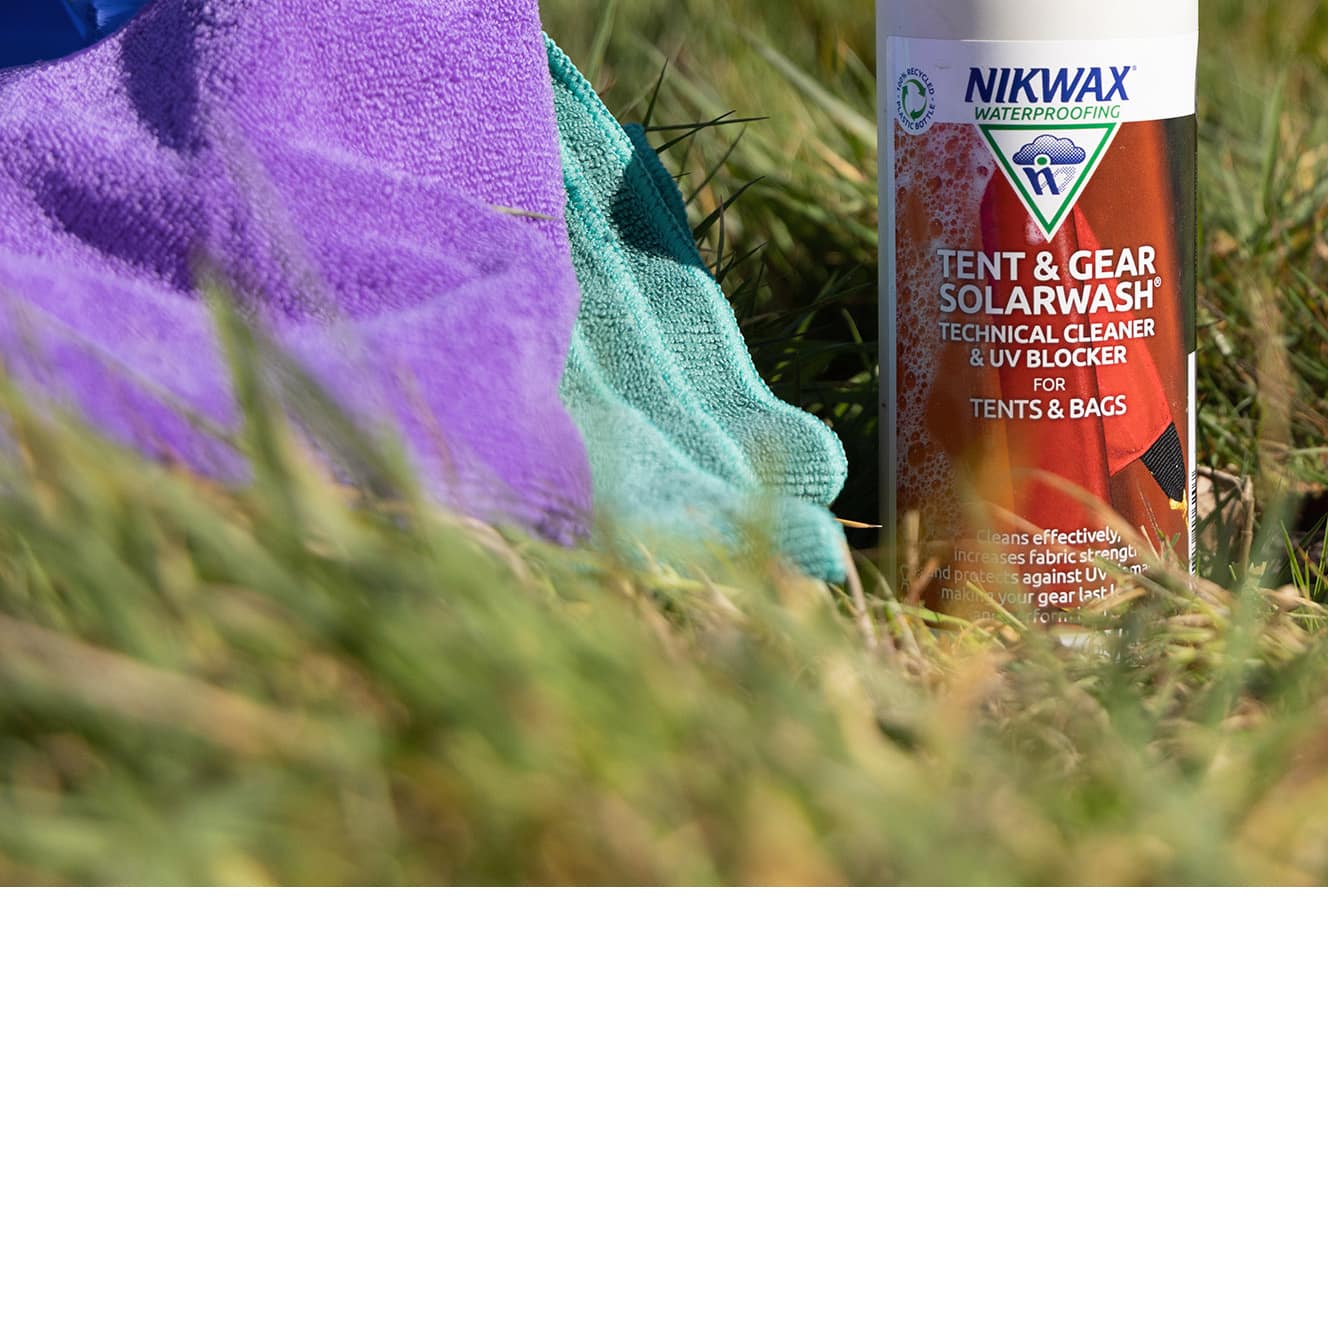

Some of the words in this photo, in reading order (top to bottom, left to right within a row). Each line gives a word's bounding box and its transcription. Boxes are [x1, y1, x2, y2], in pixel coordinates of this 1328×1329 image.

[965, 65, 1131, 103] NIKWAX
[974, 105, 1121, 121] WATERPROOFING
[937, 249, 1025, 281] TENT
[1033, 251, 1060, 281] &
[1068, 246, 1156, 277] GEAR
[939, 322, 1059, 344] TECHNICAL
[1064, 319, 1155, 343] CLEANER
[969, 350, 984, 367] &
[990, 350, 1021, 367] UV
[1026, 345, 1127, 367] BLOCKER
[1033, 378, 1066, 391] FOR
[969, 398, 1042, 419] TENTS
[1047, 399, 1065, 419] &
[1070, 395, 1127, 418] BAGS
[976, 529, 1029, 545] Cleans
[1033, 526, 1121, 545] effectively,
[954, 547, 1025, 565] increases
[1029, 549, 1077, 565] fabric
[1023, 569, 1082, 587] against
[1086, 567, 1107, 583] UV
[1038, 591, 1076, 607] gear
